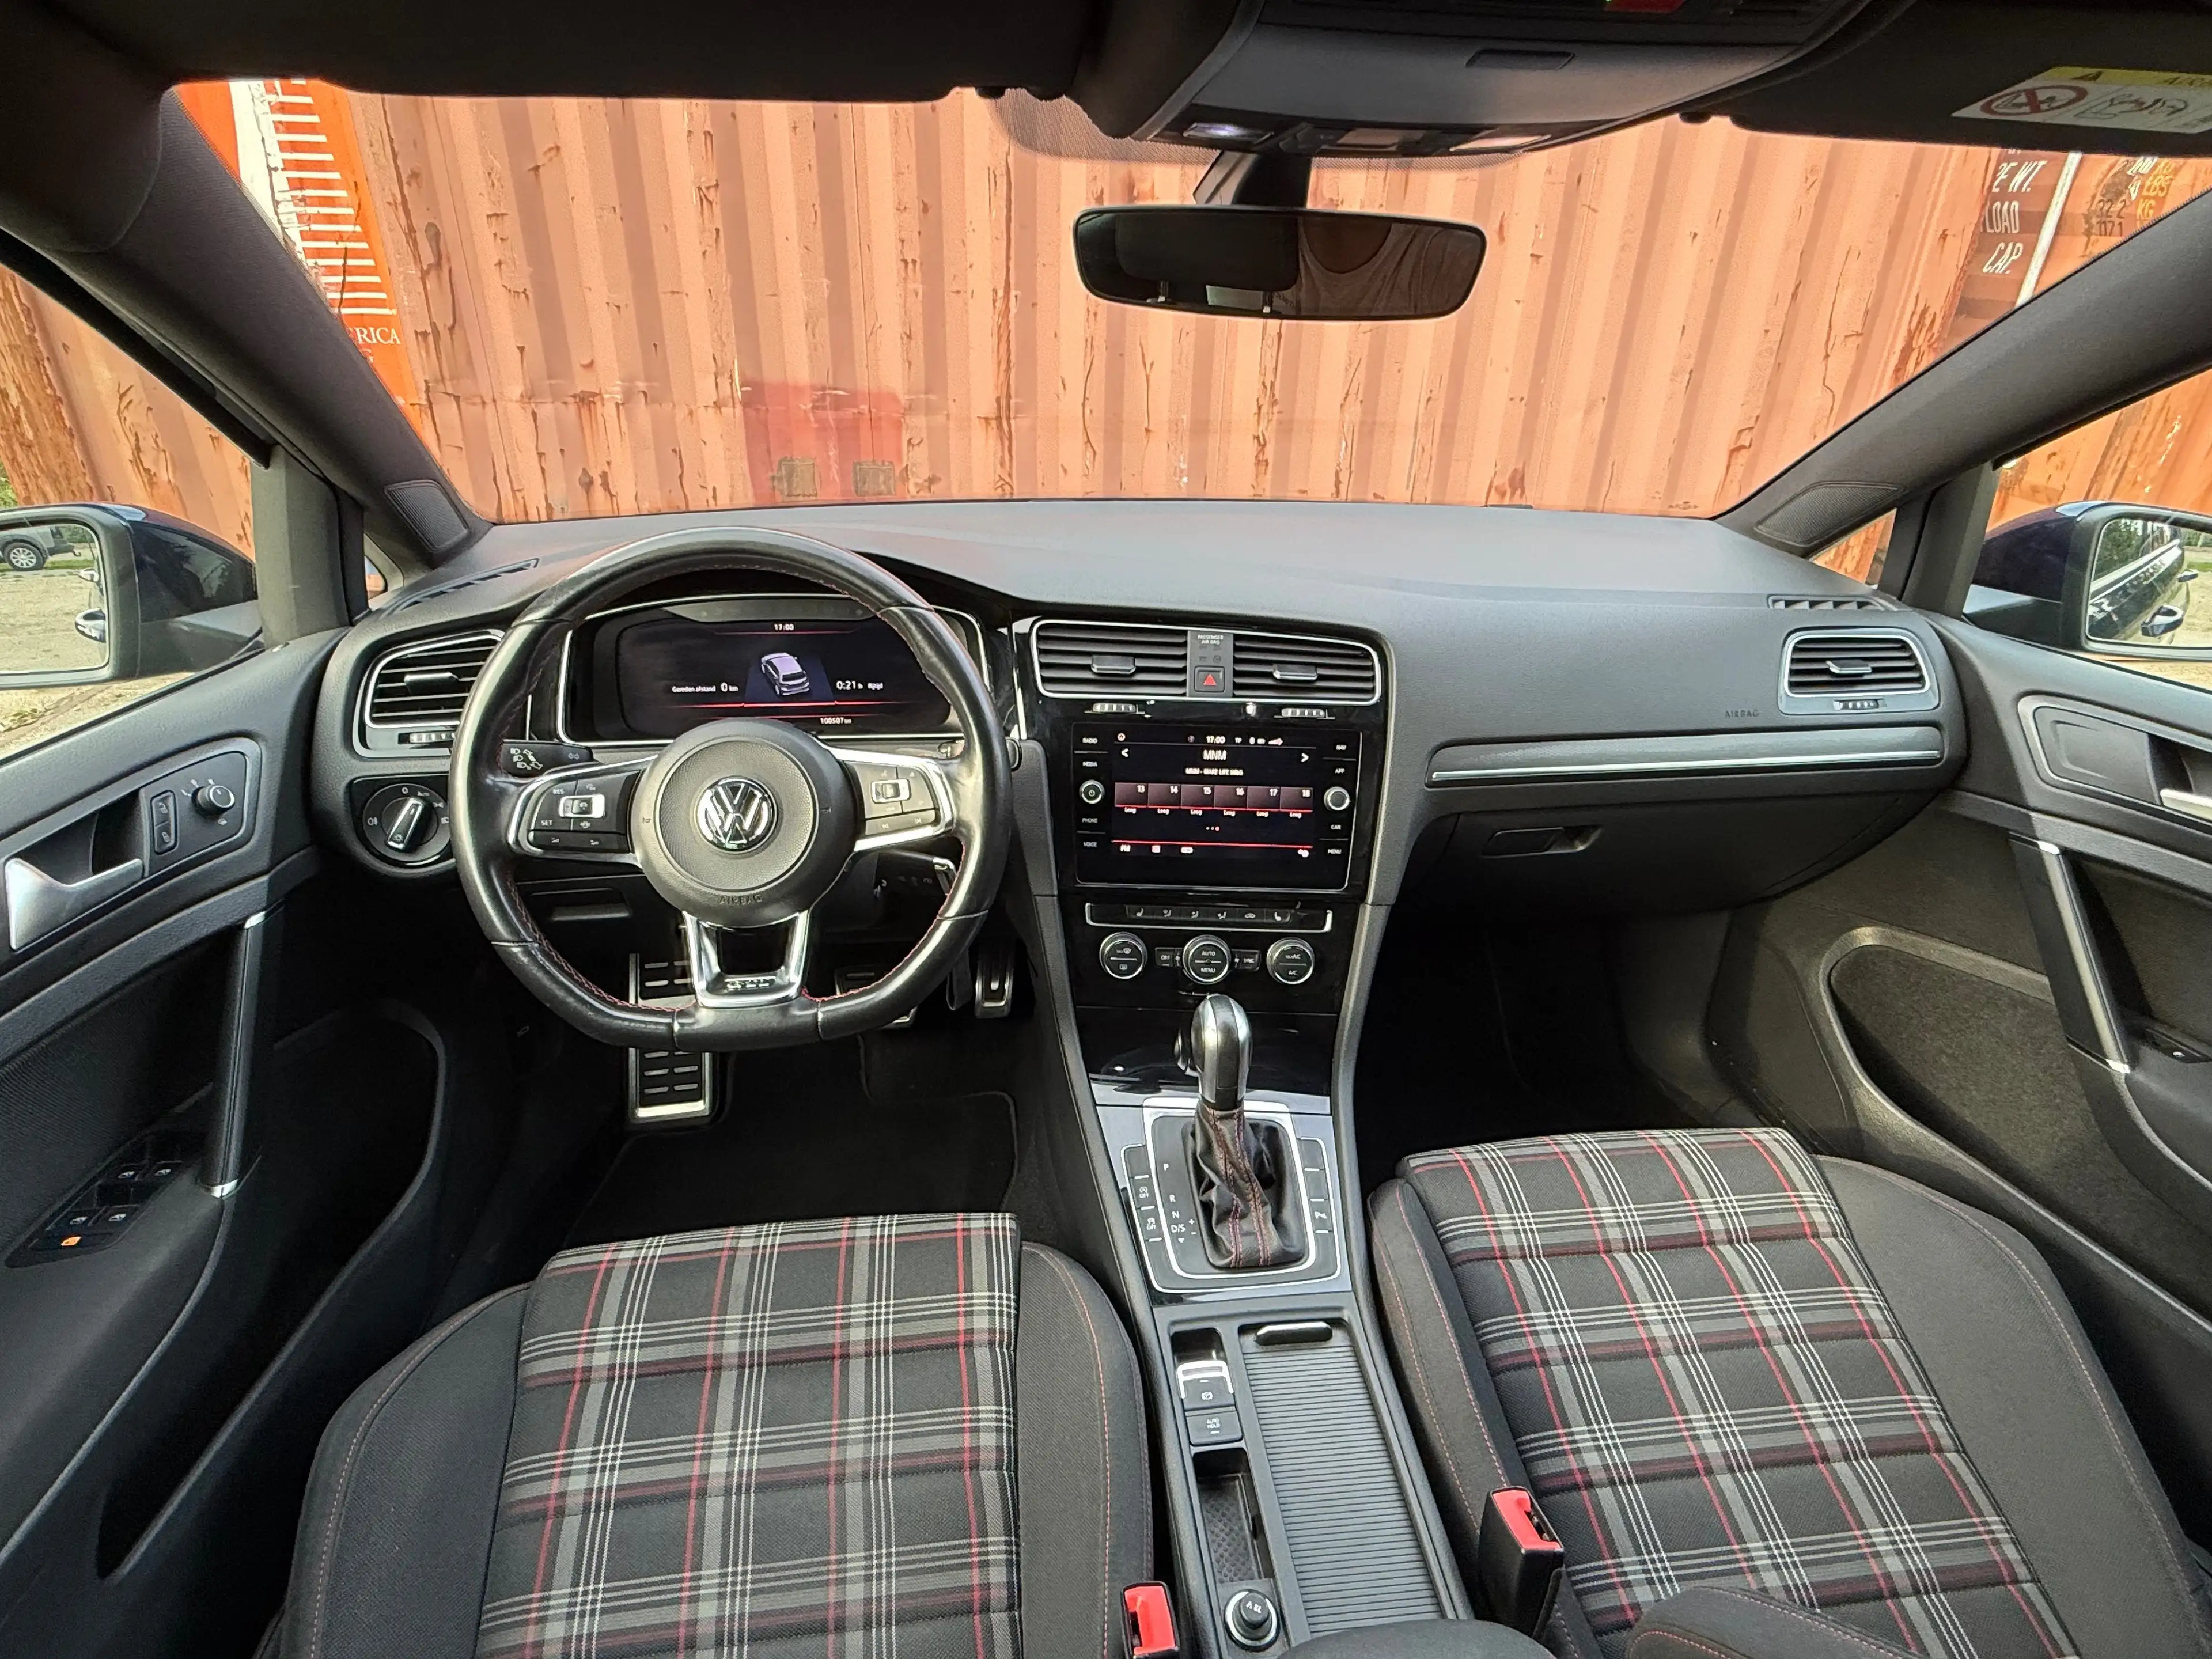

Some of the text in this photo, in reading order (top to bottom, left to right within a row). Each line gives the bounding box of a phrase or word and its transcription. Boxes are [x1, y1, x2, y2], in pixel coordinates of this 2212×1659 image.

[2008, 160, 2048, 192] WT.
[1983, 241, 2024, 274] CAP.
[347, 327, 402, 344] RICA
[774, 623, 794, 631] 17:00
[721, 682, 728, 692] 0
[836, 680, 856, 690] 0:21
[1725, 709, 1760, 718] AIRBAG
[1206, 735, 1226, 744] 17:00
[1203, 749, 1227, 760] MNM
[719, 895, 763, 905] AIRBAG
[1163, 1163, 1169, 1171] P
[1169, 1194, 1176, 1202] R
[1172, 1210, 1180, 1219] N
[1171, 1224, 1186, 1233] D/S
